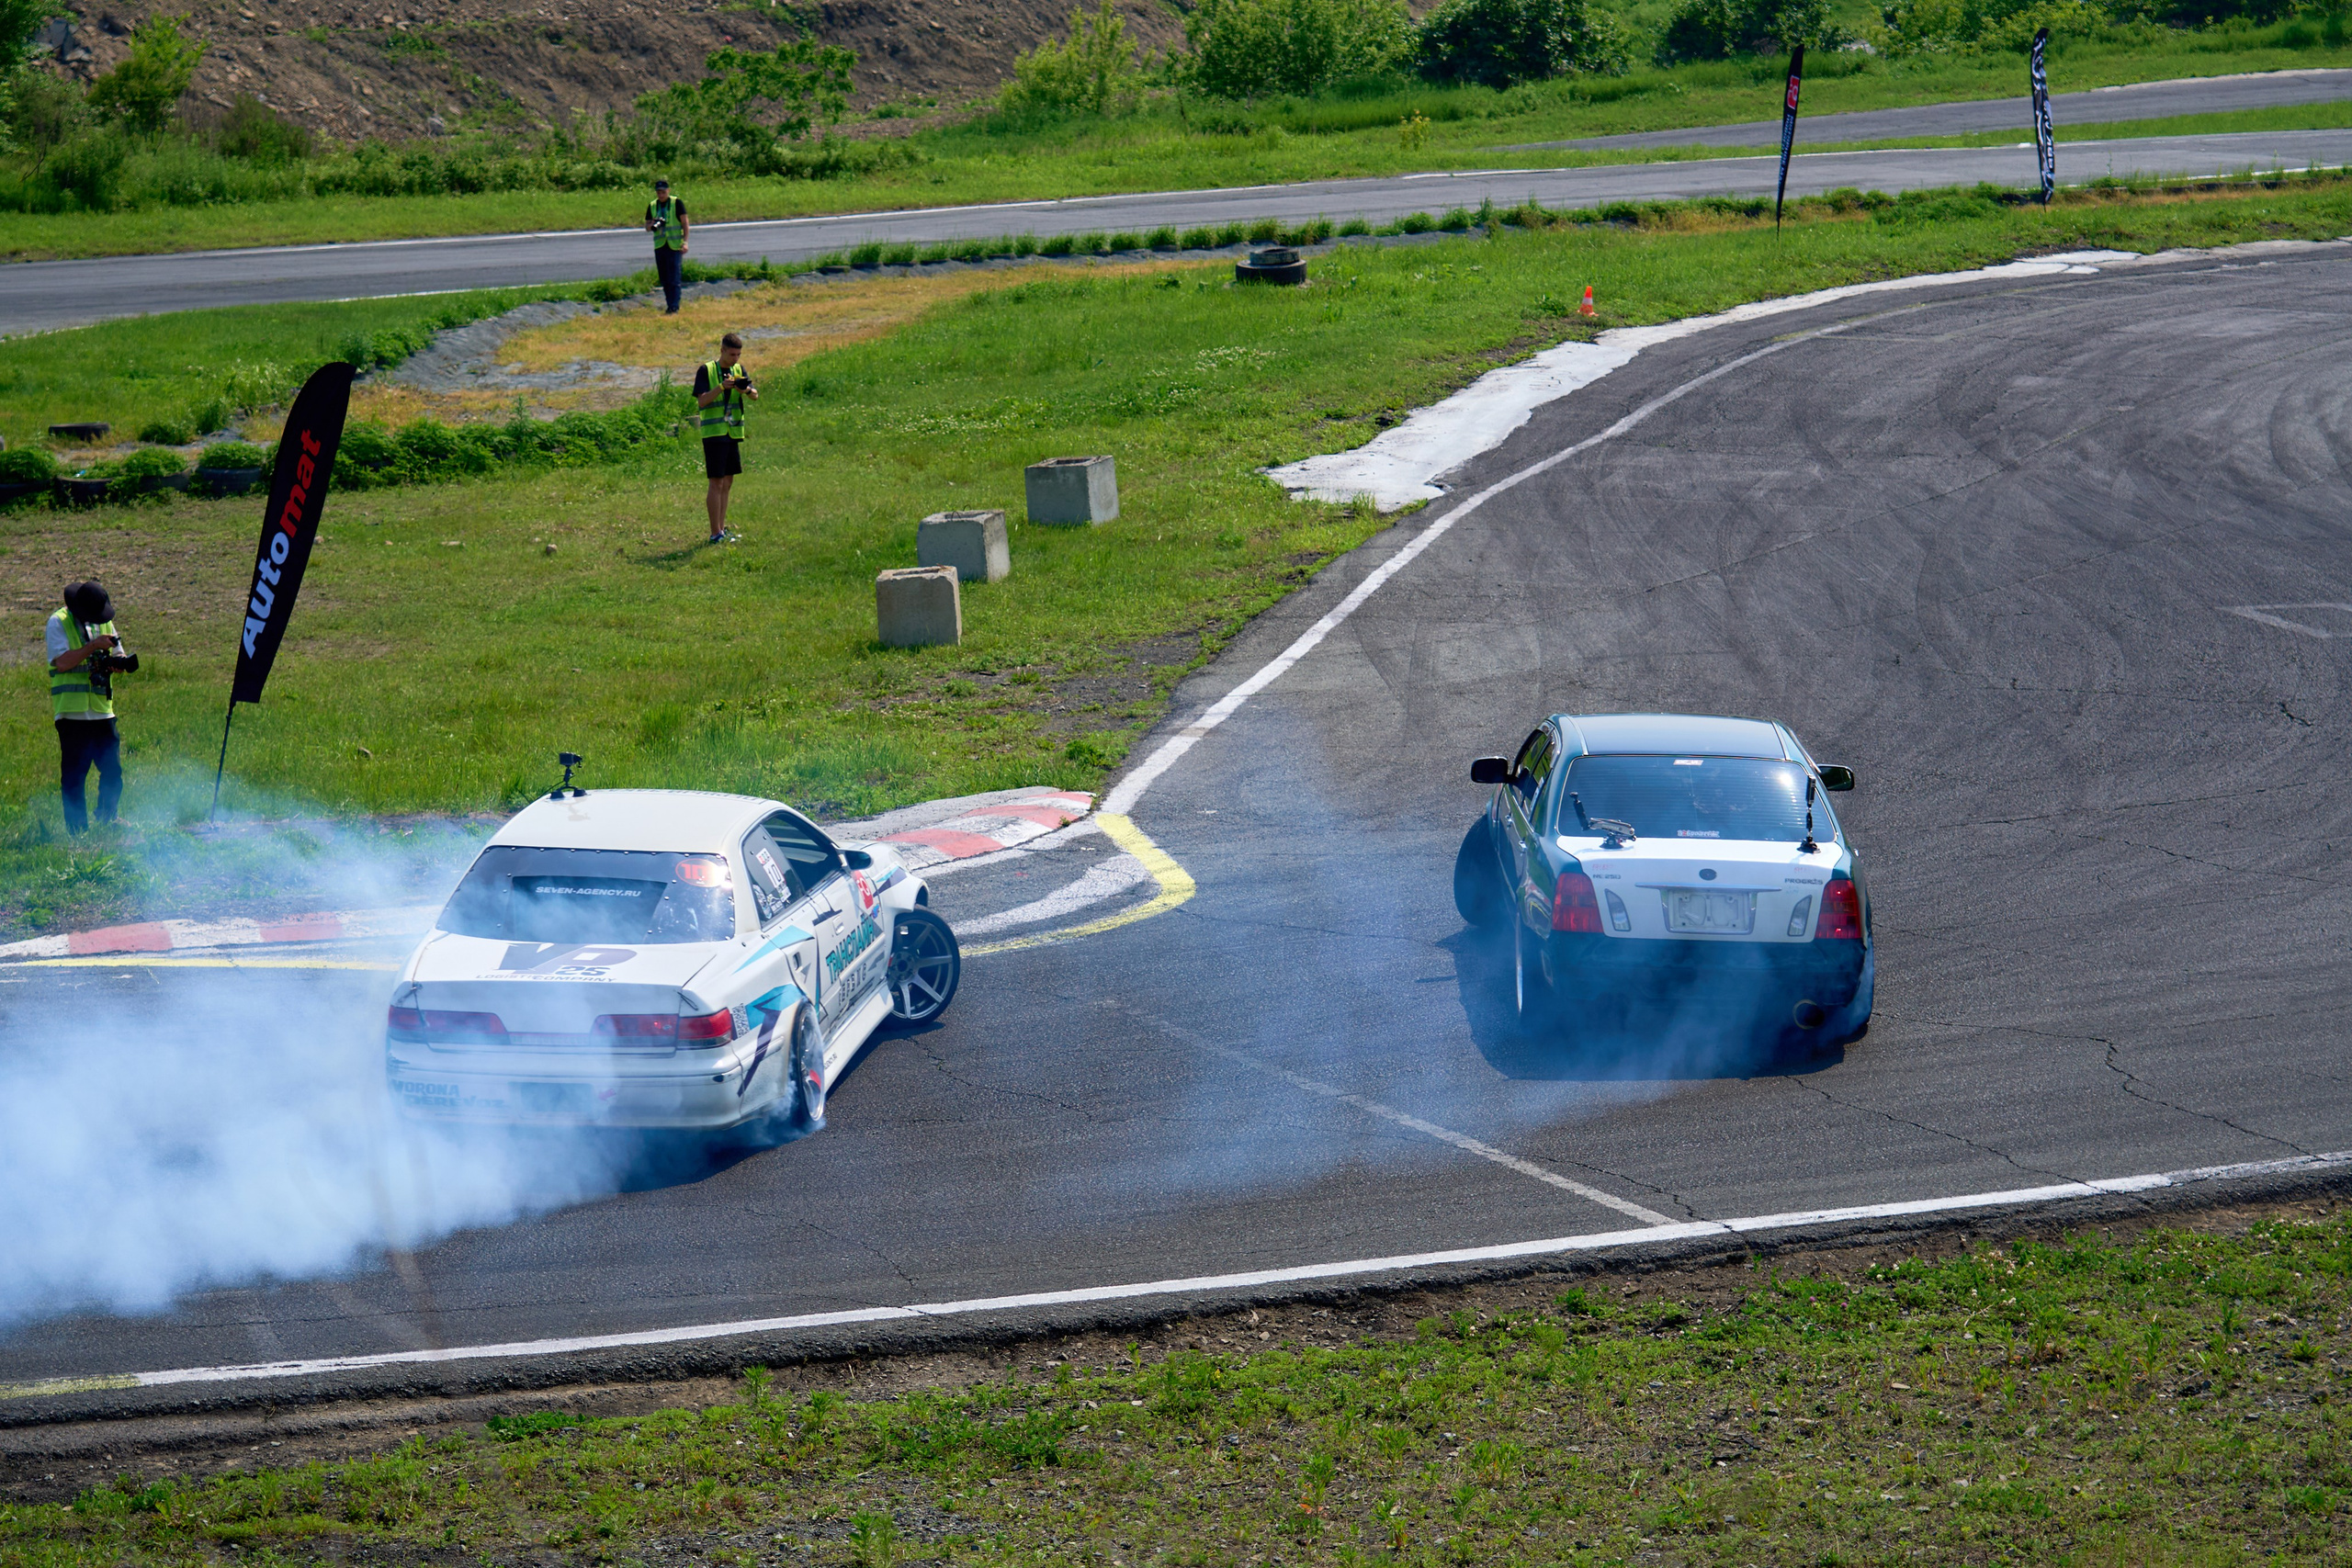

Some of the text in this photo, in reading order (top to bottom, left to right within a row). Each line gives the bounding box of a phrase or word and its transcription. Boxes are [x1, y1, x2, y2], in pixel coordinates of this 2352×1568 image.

[243, 428, 322, 660] Automat
[767, 863, 781, 887] 10
[536, 886, 642, 897] SEVEN-AGENCY.RU
[555, 965, 611, 976] 25
[390, 1078, 461, 1097] VORONA
